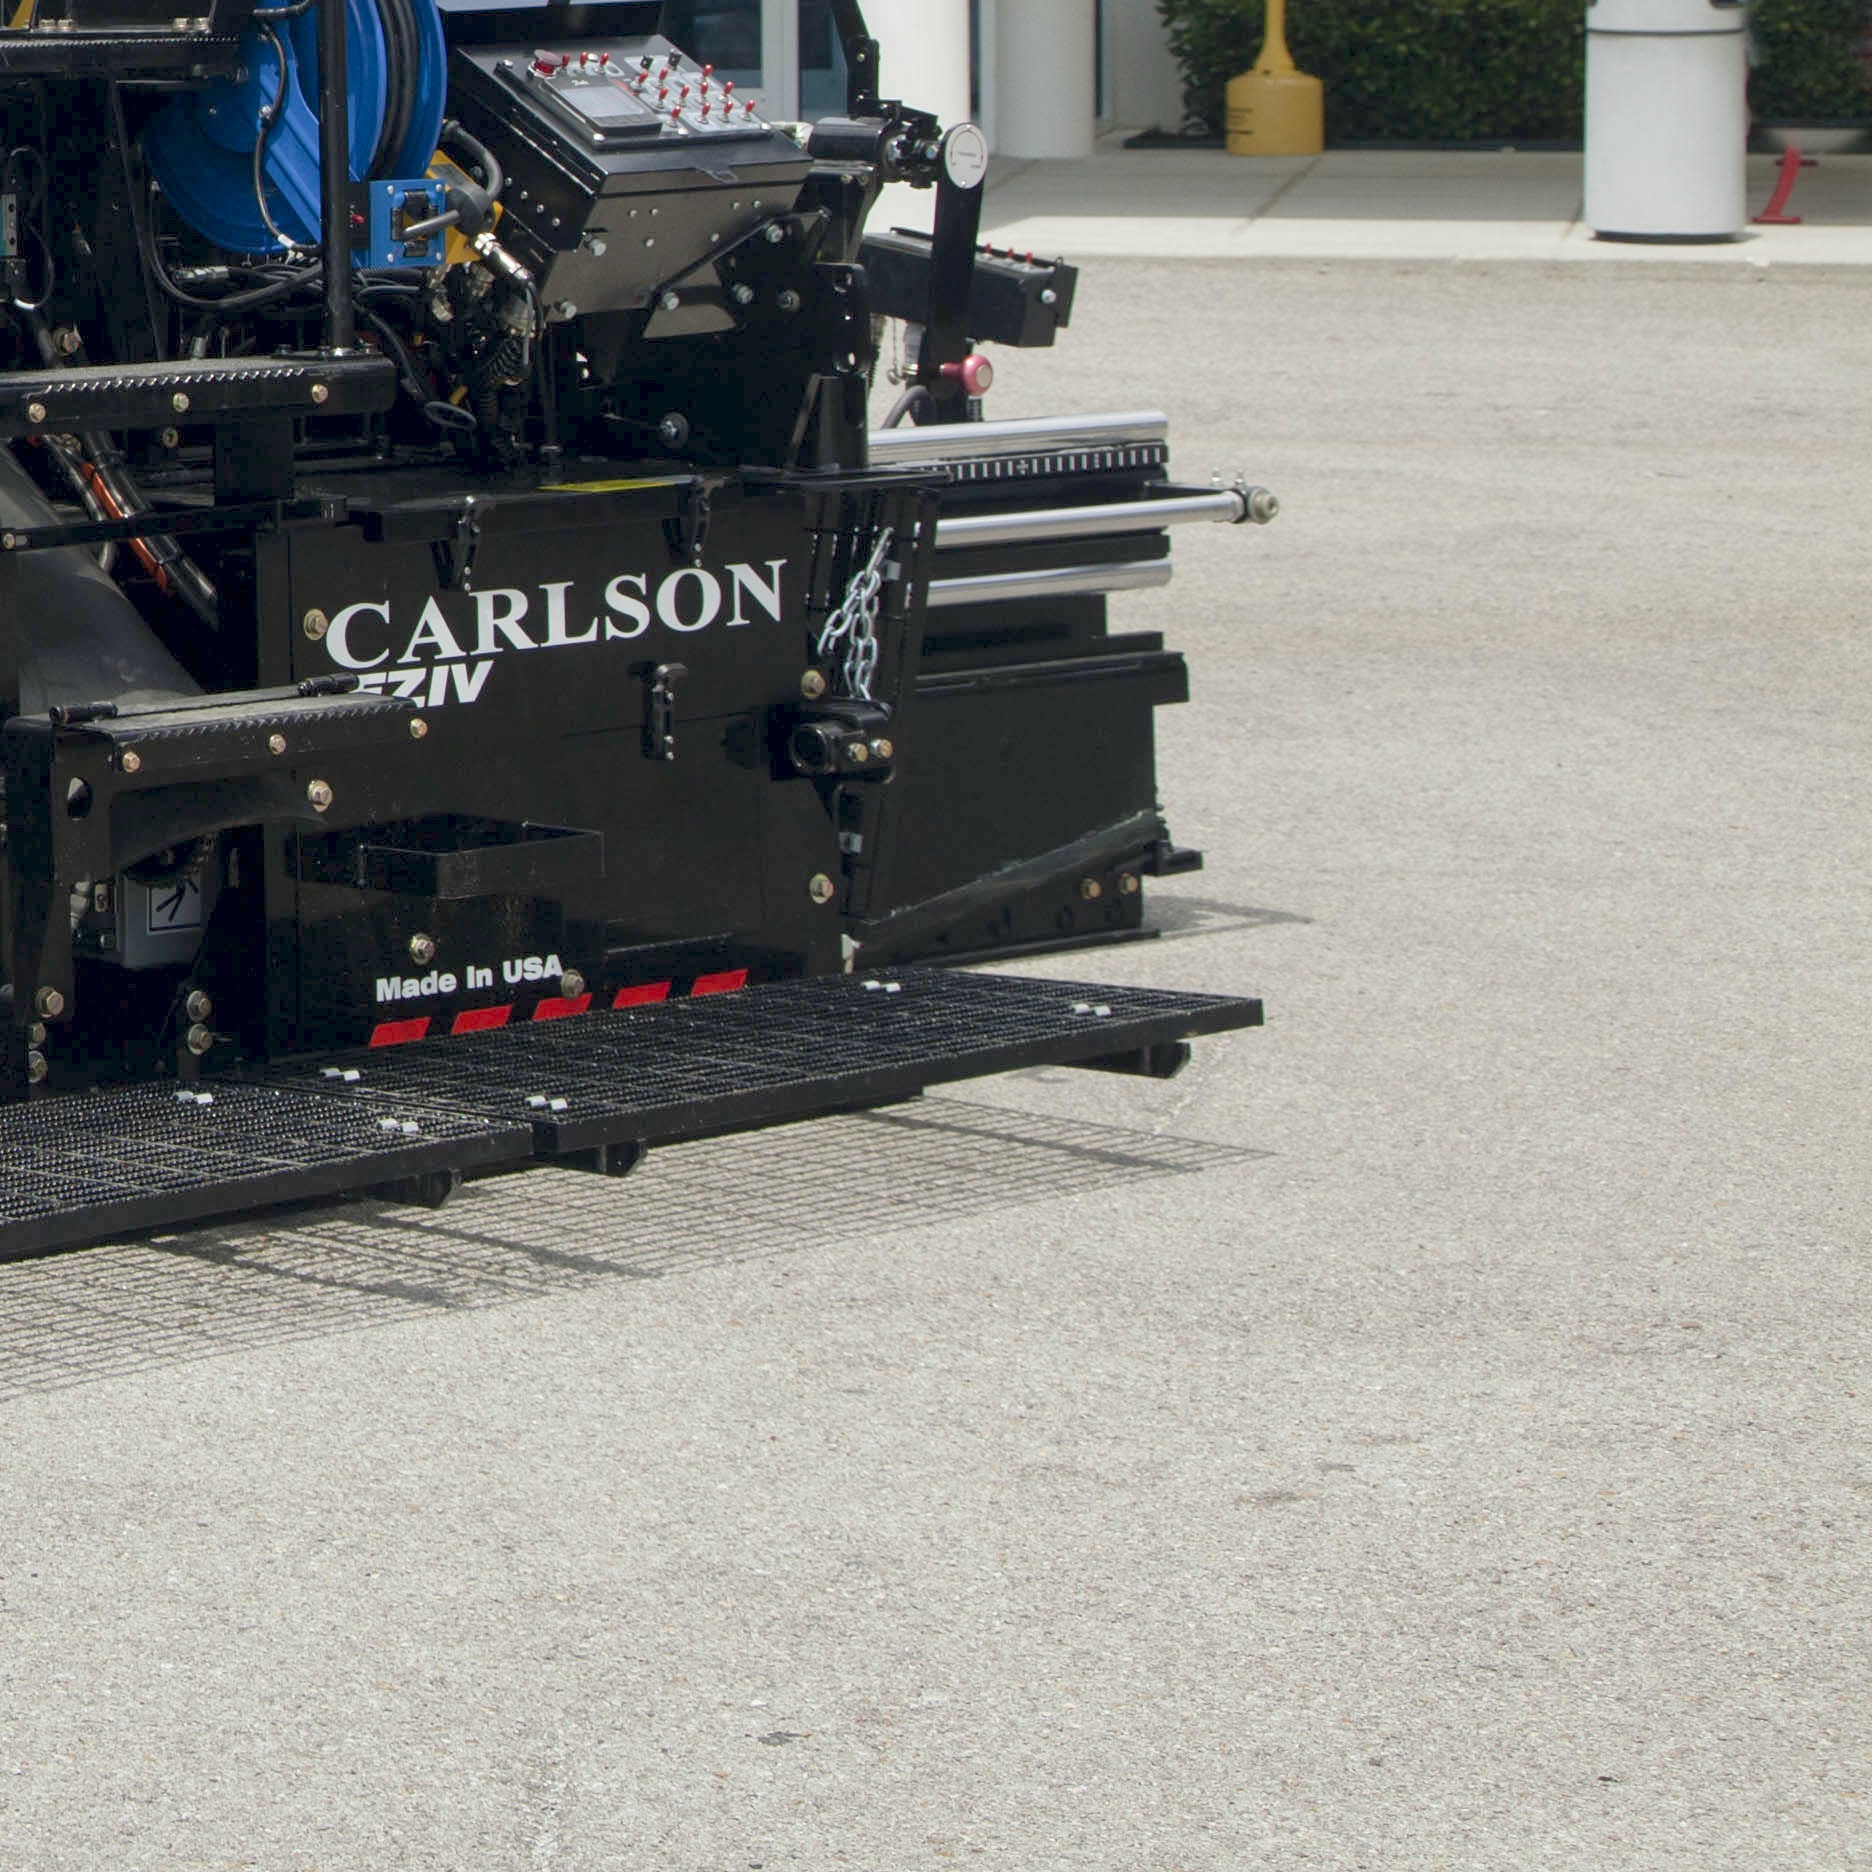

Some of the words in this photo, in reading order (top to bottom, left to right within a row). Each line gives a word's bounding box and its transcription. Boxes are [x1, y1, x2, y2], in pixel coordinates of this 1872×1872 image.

[325, 559, 787, 669] CARLSON
[376, 970, 456, 1002] Made
[466, 965, 492, 989] In
[502, 954, 564, 983] USA
